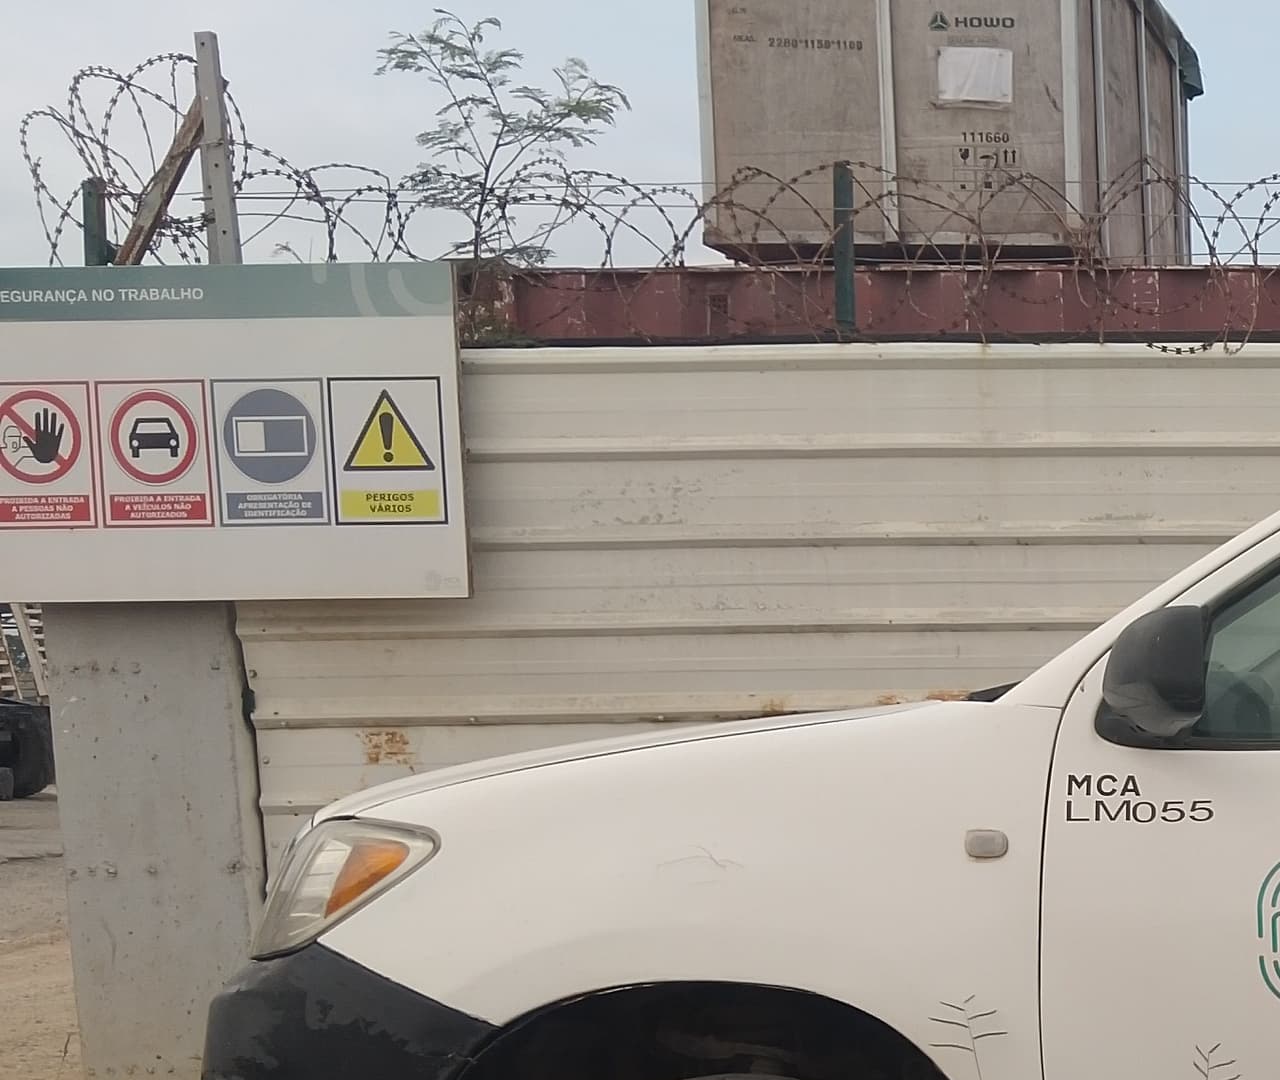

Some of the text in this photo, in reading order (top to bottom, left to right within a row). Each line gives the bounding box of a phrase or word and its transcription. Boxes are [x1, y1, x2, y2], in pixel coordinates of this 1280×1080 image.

[954, 16, 1016, 29] HOWO
[961, 131, 1010, 144] 111660
[0, 287, 205, 305] EGURANÇA NO TRABALHO
[365, 493, 415, 502] PERIGOS
[56, 504, 74, 512] NÃO
[174, 502, 192, 510] NÃO
[369, 503, 413, 513] VÁRIOS
[1067, 774, 1141, 797] MCA
